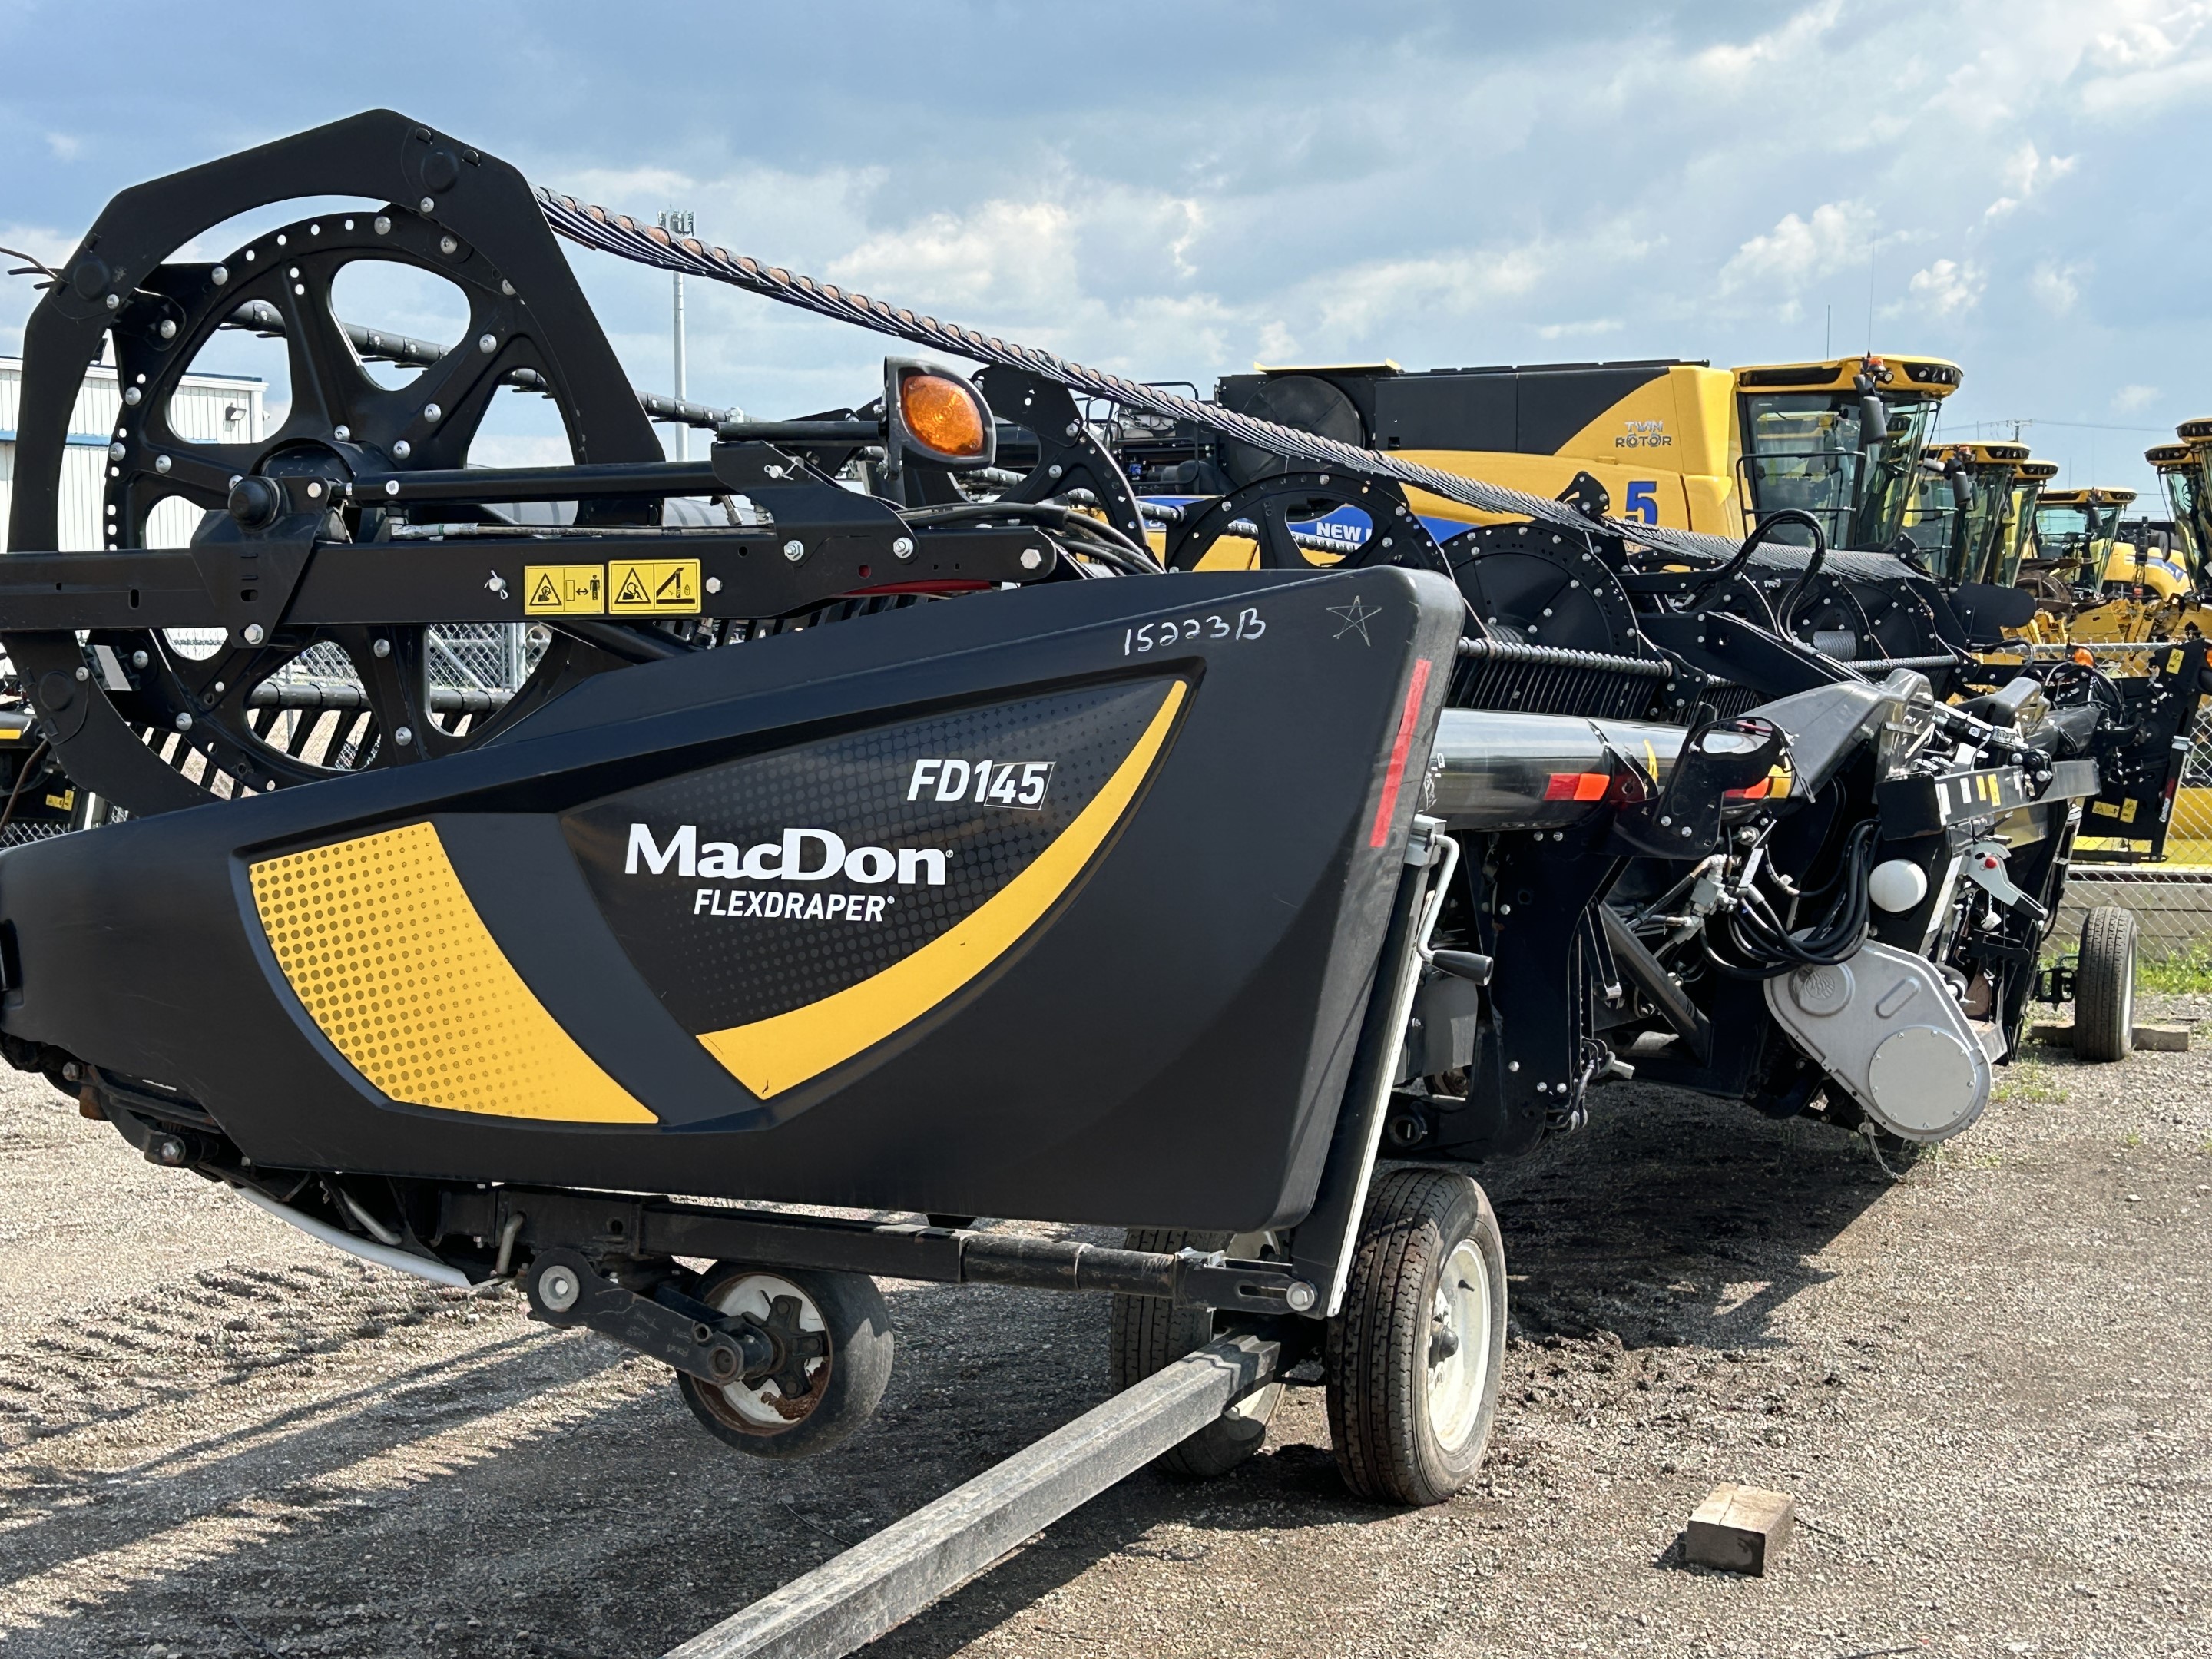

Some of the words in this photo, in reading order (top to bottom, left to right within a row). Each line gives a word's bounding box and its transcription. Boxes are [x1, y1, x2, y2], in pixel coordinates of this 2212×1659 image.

[1624, 420, 1664, 432] TWIN
[1615, 434, 1672, 448] ROTOR
[1316, 522, 1363, 541] NEW
[1124, 608, 1267, 656] 15223B
[906, 758, 1049, 805] FD145
